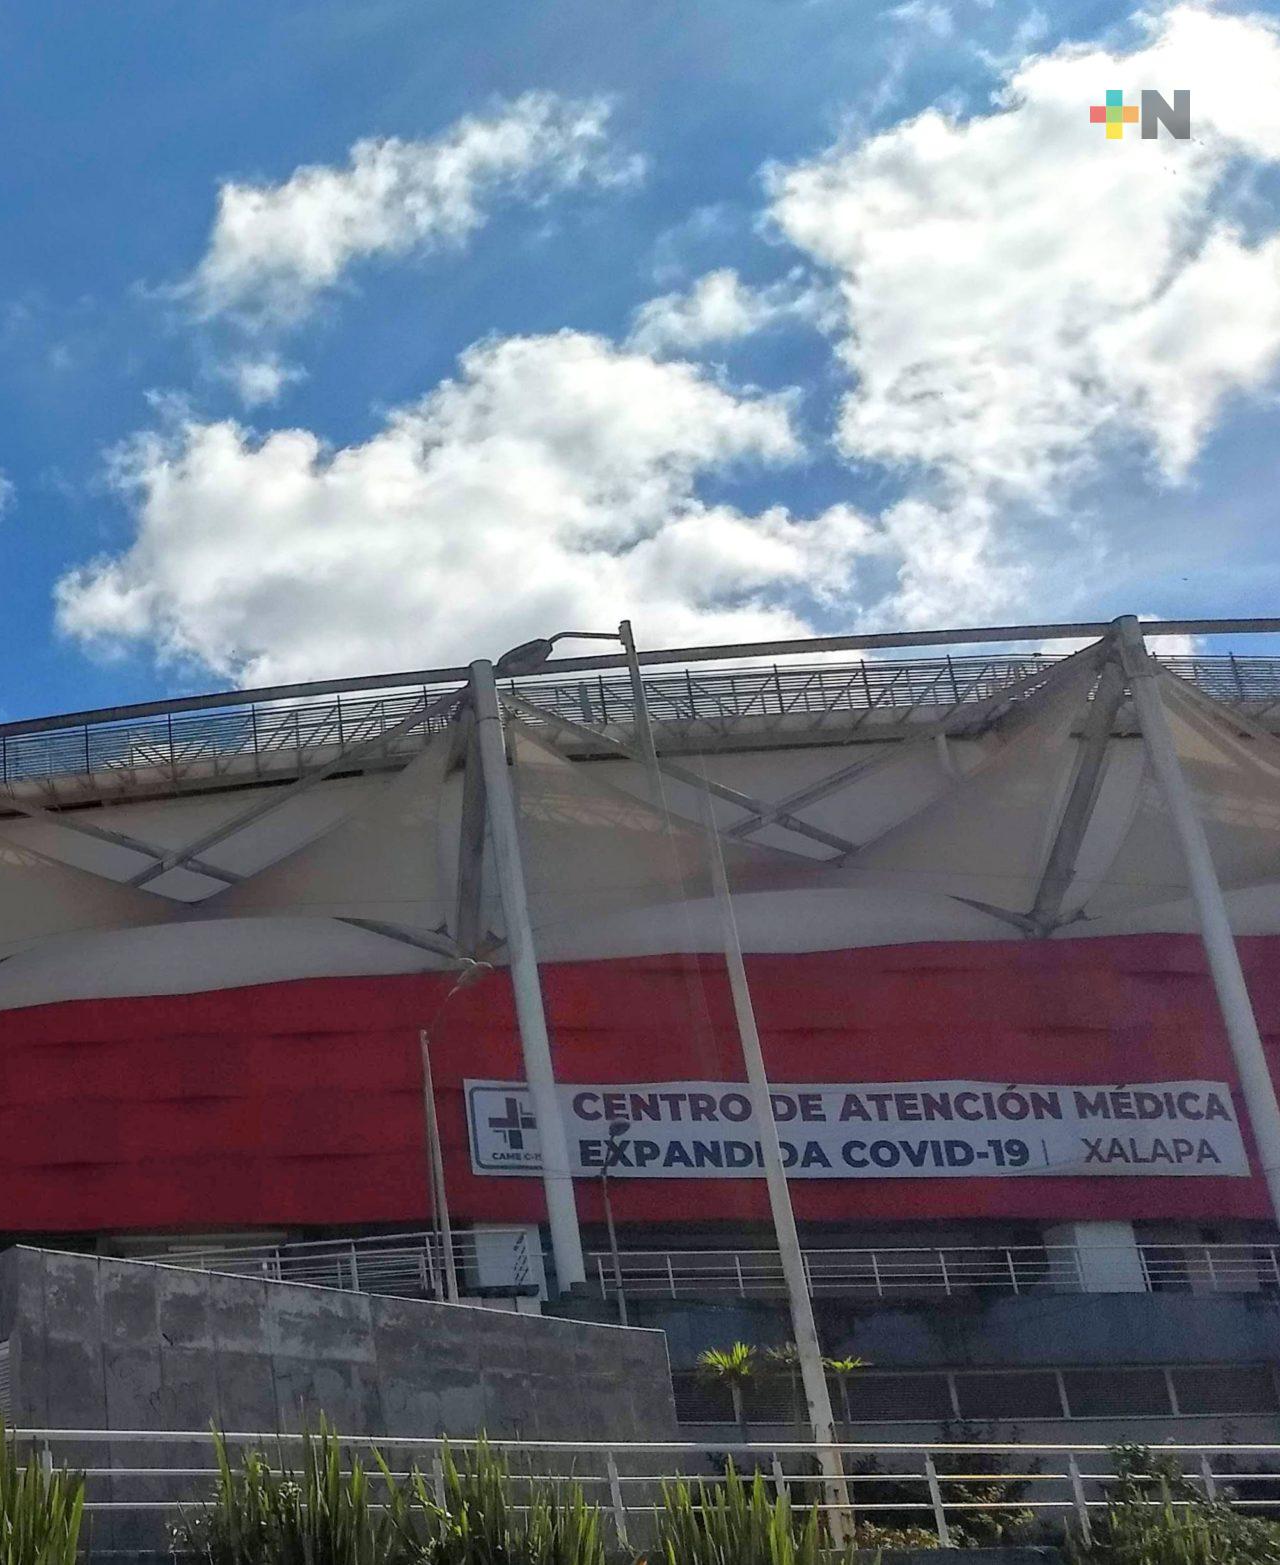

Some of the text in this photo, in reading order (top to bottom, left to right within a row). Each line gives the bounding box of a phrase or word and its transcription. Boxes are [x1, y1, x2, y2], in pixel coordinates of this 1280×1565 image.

[573, 1084, 1232, 1122] CENTRO DE ATENCIÓN MÉDICA
[842, 1139, 1030, 1168] COVID-19
[1081, 1138, 1222, 1163] XALAPA
